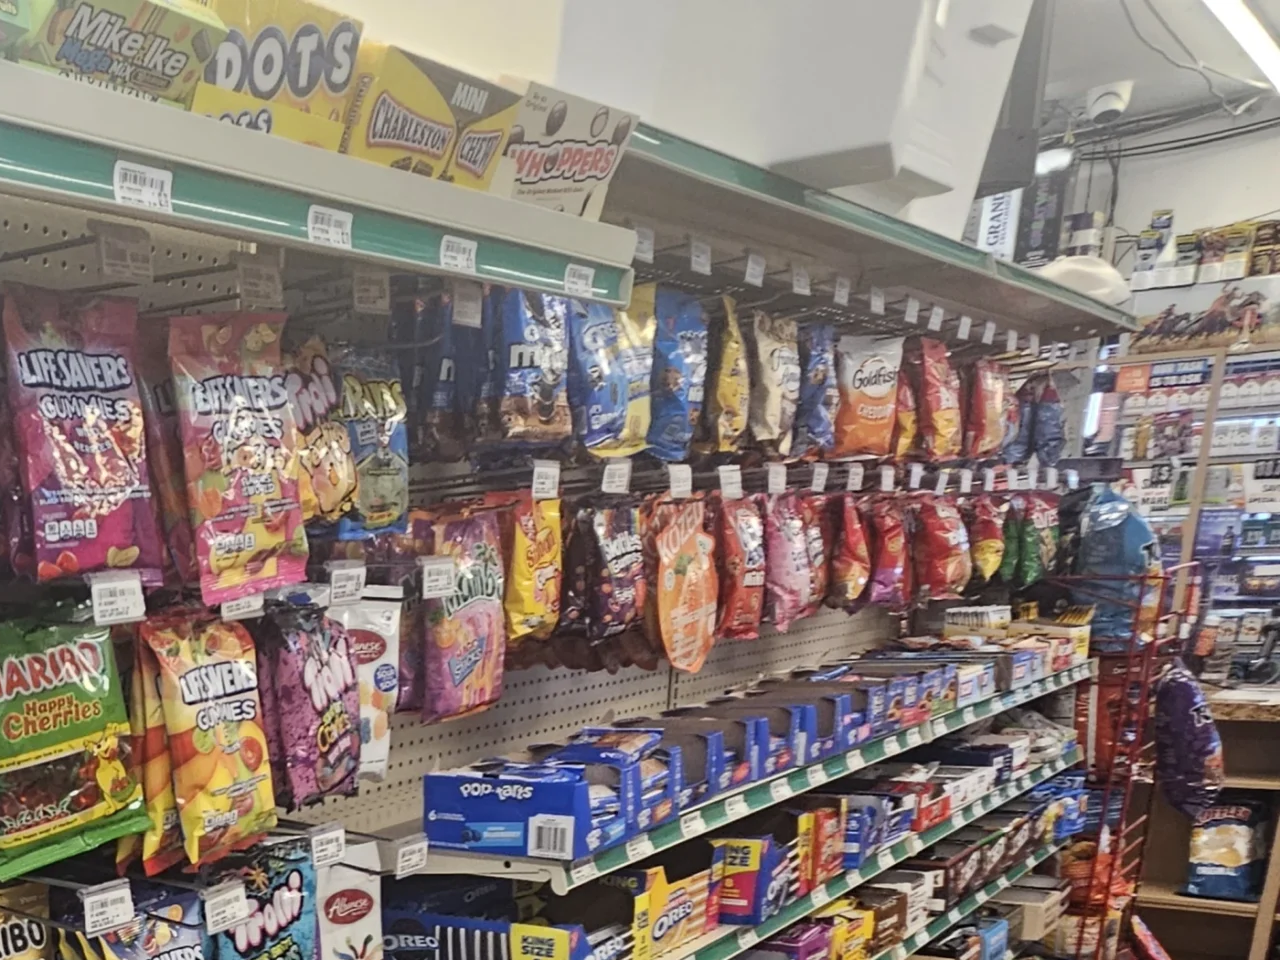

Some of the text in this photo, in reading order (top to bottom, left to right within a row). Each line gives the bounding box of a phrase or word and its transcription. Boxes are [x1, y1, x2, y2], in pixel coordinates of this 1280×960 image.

[65, 2, 188, 77] Mike Ike
[215, 27, 356, 93] DOTS
[451, 82, 489, 114] MINI
[373, 97, 501, 174] CHARLESTON CHEW
[516, 143, 615, 184] WHOPPERS
[852, 366, 900, 391] Goldfish
[38, 394, 135, 423] GUMMIES
[3, 701, 102, 742] Cherries
[24, 694, 75, 720] Happy
[196, 701, 257, 731] GUMMIES
[427, 810, 437, 821] 6
[651, 900, 693, 942] OREO
[381, 934, 439, 950] OREO
[520, 935, 556, 948] KING
[520, 944, 556, 958] SIZE
